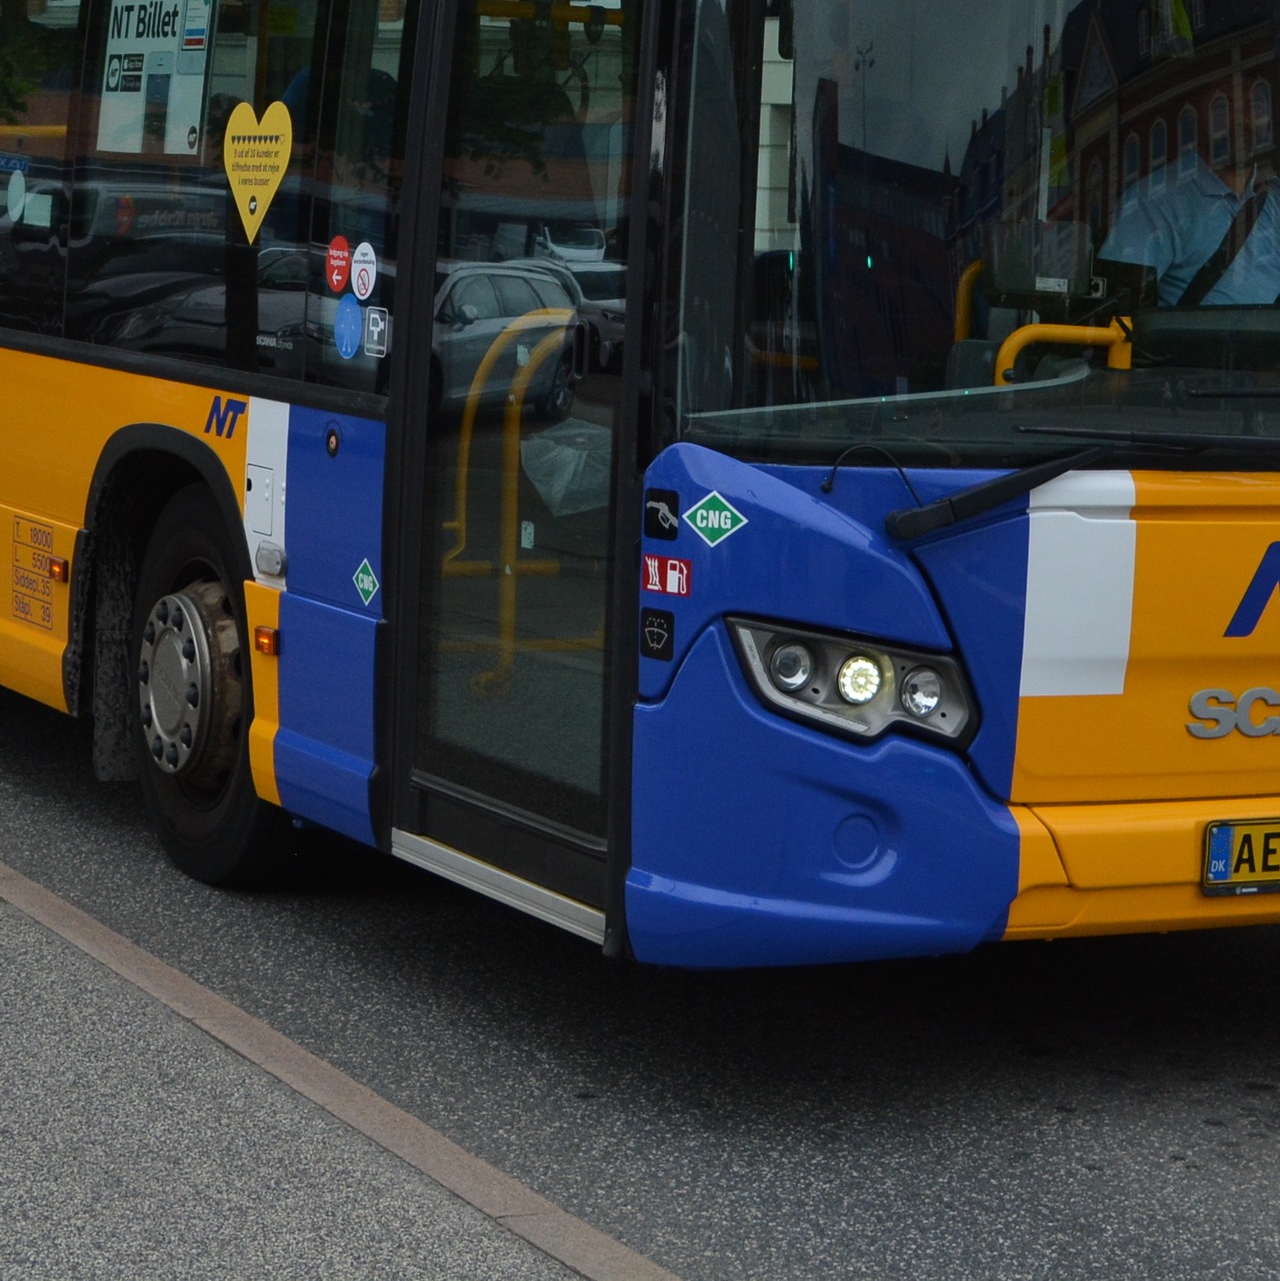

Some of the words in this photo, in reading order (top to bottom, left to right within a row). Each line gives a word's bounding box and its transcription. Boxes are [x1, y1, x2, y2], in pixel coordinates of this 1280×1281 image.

[111, 5, 135, 39] NT
[135, 0, 179, 38] Billet
[203, 395, 247, 440] NT
[696, 508, 732, 529] CNG
[30, 527, 51, 548] 18000
[358, 572, 373, 591] CNG
[41, 605, 51, 623] 39
[1211, 859, 1226, 872] DK
